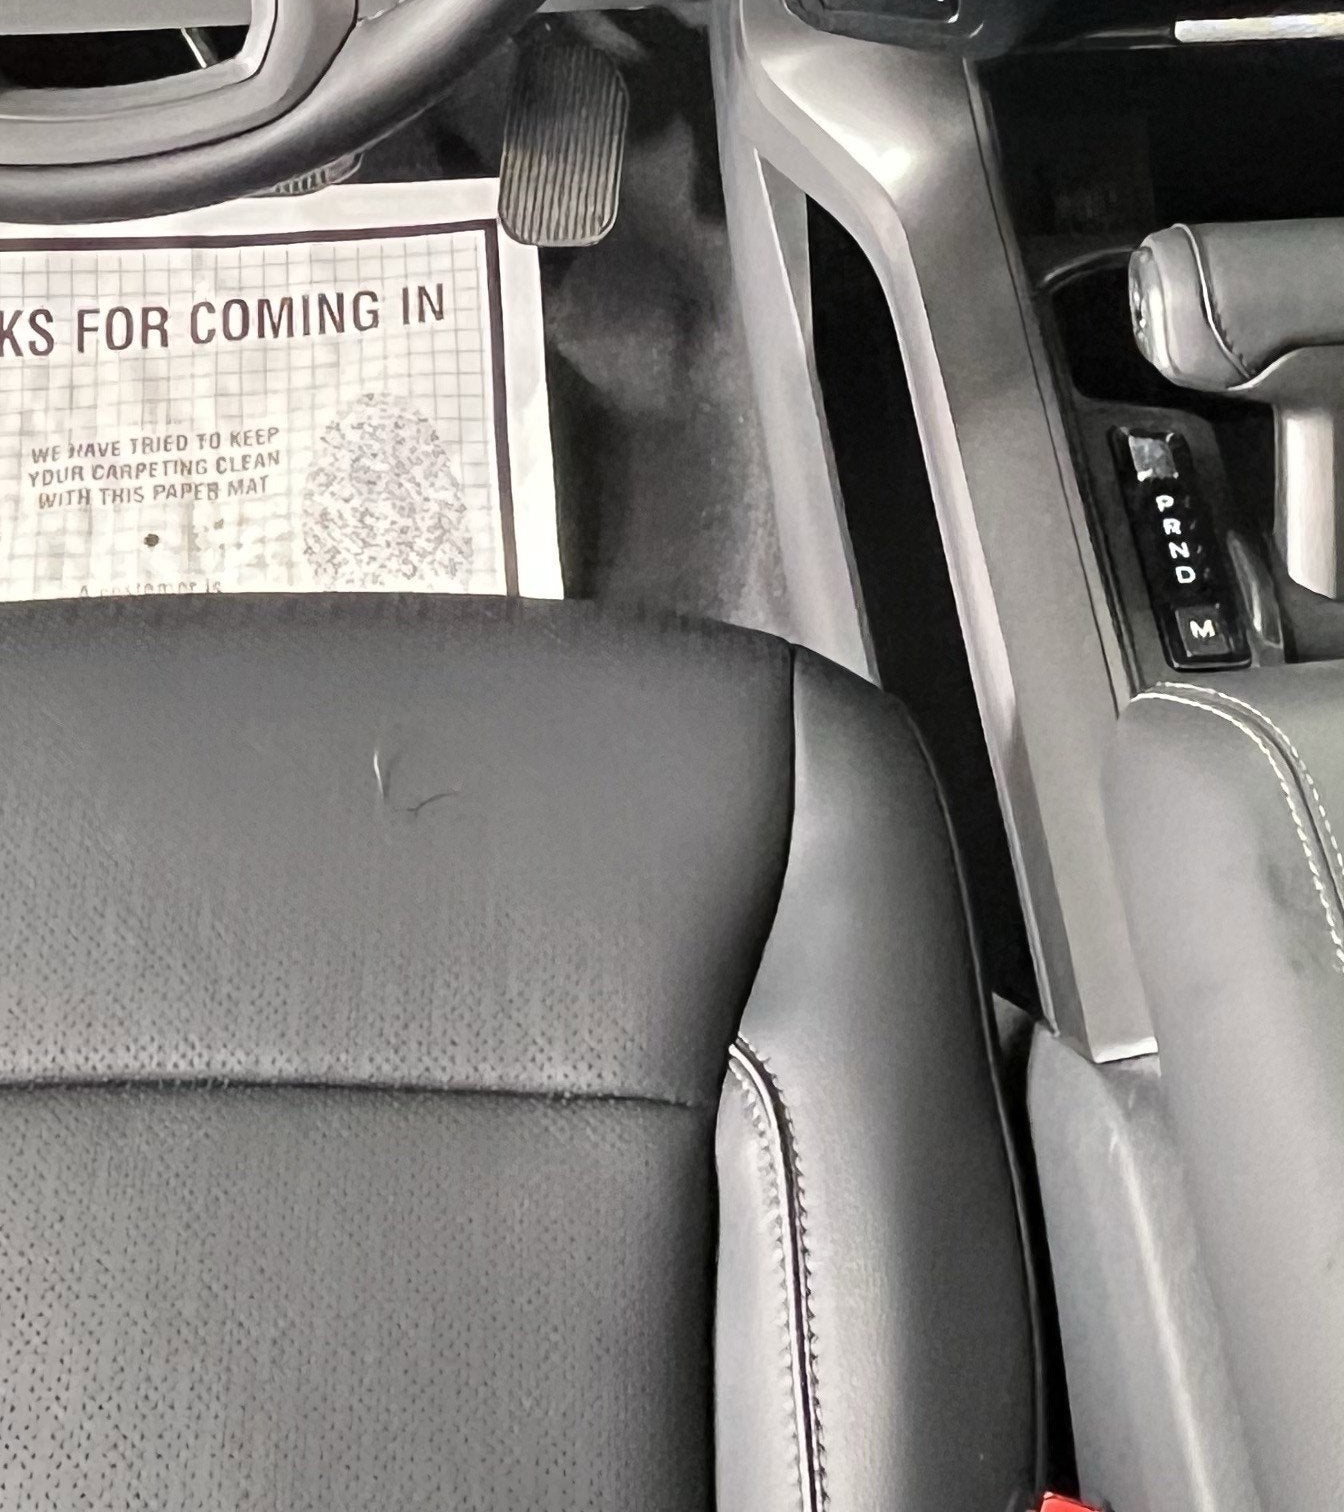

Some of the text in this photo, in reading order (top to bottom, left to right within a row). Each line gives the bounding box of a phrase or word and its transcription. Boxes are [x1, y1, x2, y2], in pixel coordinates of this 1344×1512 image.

[76, 305, 170, 354] FOR
[189, 289, 380, 345] COMING
[401, 283, 445, 325] IN
[31, 426, 280, 464] WE HAVE TRIED TO KEEP
[28, 449, 281, 487] YOUR CARPETING CLEAN
[38, 474, 270, 510] WITH THIS PAPER MAT
[1156, 494, 1196, 584] P R N D
[1189, 619, 1216, 638] M
